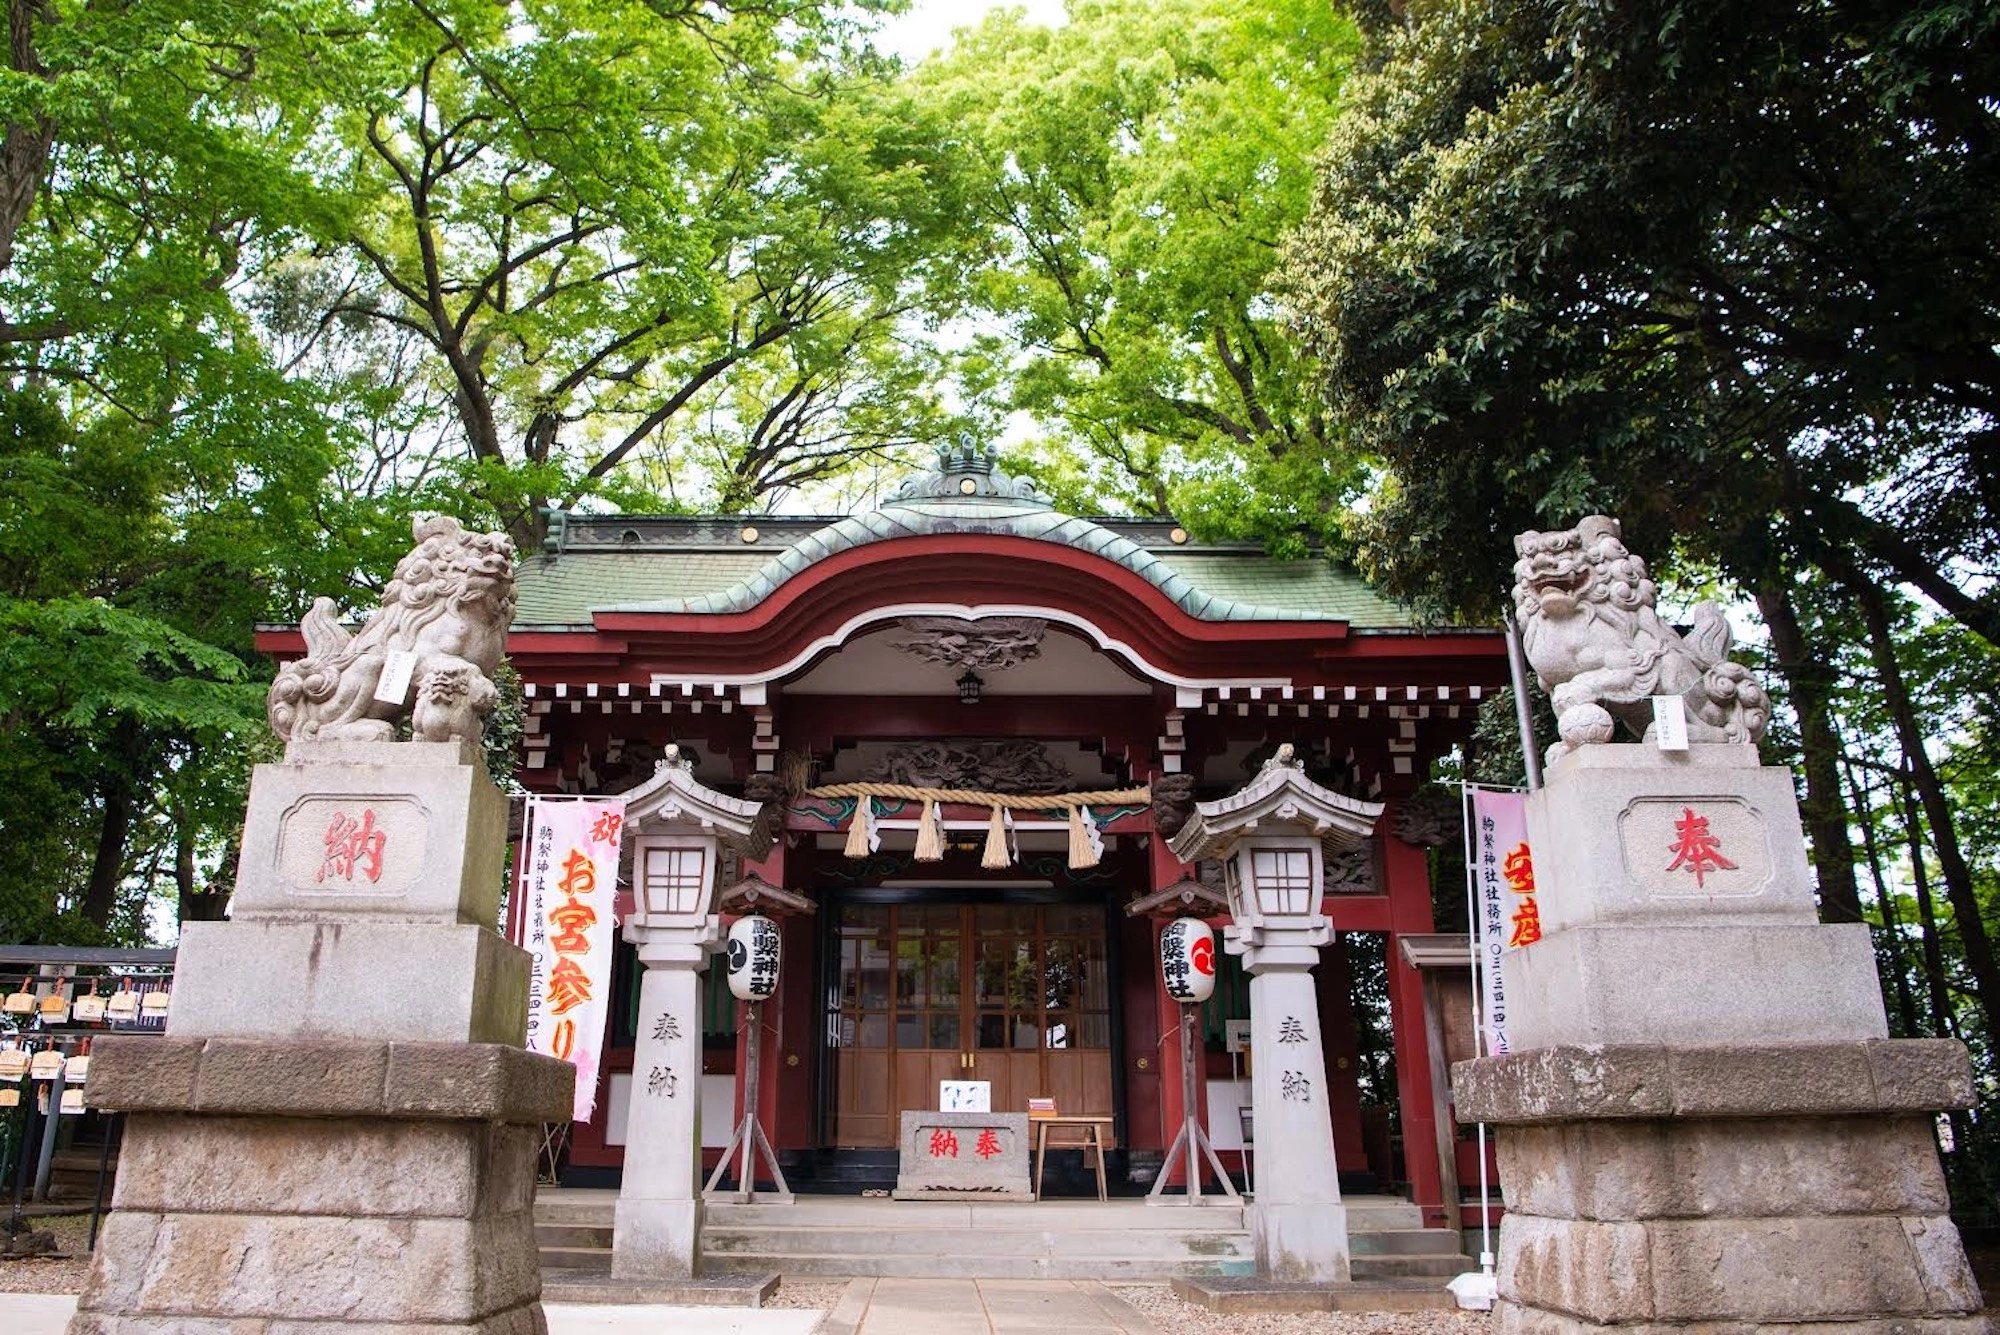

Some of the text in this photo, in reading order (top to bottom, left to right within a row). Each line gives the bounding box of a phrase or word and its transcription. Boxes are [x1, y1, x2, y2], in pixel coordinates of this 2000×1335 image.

[314, 809, 386, 883] 納
[589, 811, 622, 846] 祝
[1666, 804, 1739, 888] 奉
[547, 848, 598, 1061] お宮参り
[648, 1012, 682, 1098] 奉納
[1278, 1016, 1310, 1103] 奉納
